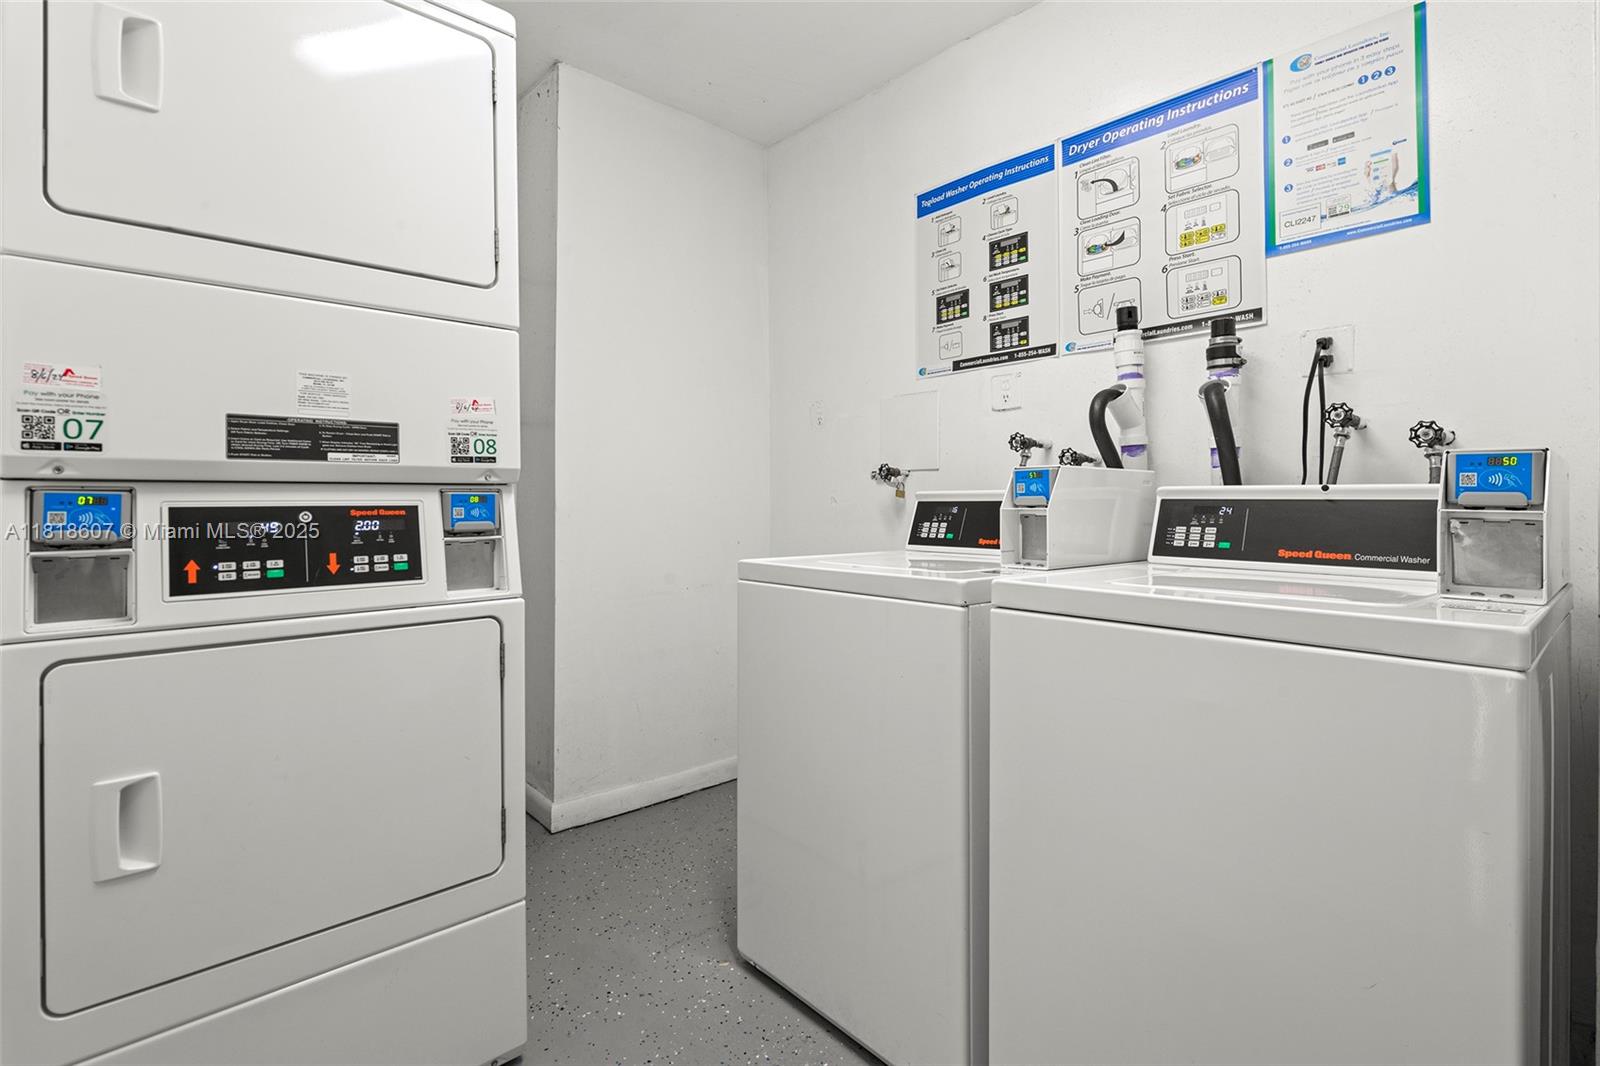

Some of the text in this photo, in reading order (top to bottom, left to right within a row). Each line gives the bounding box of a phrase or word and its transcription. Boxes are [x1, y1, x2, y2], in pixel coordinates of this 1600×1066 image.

[1068, 82, 1250, 158] Dryer Operating Instructions
[1160, 140, 1166, 150] 2
[920, 192, 946, 209] Topload
[946, 184, 969, 198] Washer
[968, 170, 1004, 190] Operating
[1004, 155, 1050, 176] Instructions
[1160, 203, 1166, 212] 4
[1284, 214, 1317, 228] CLI2247
[1074, 227, 1079, 236] 3
[1161, 264, 1168, 274] 6
[1074, 284, 1079, 294] 5
[1142, 324, 1194, 338] cialLaundries.com
[960, 347, 1052, 368] CommercialLaundries.com 1-855-254-WASH
[63, 418, 104, 440] 07
[474, 438, 497, 455] 08
[77, 496, 94, 505] 07
[1218, 506, 1233, 515] 24
[1278, 549, 1431, 565] Speed Queen Commercial Washer
